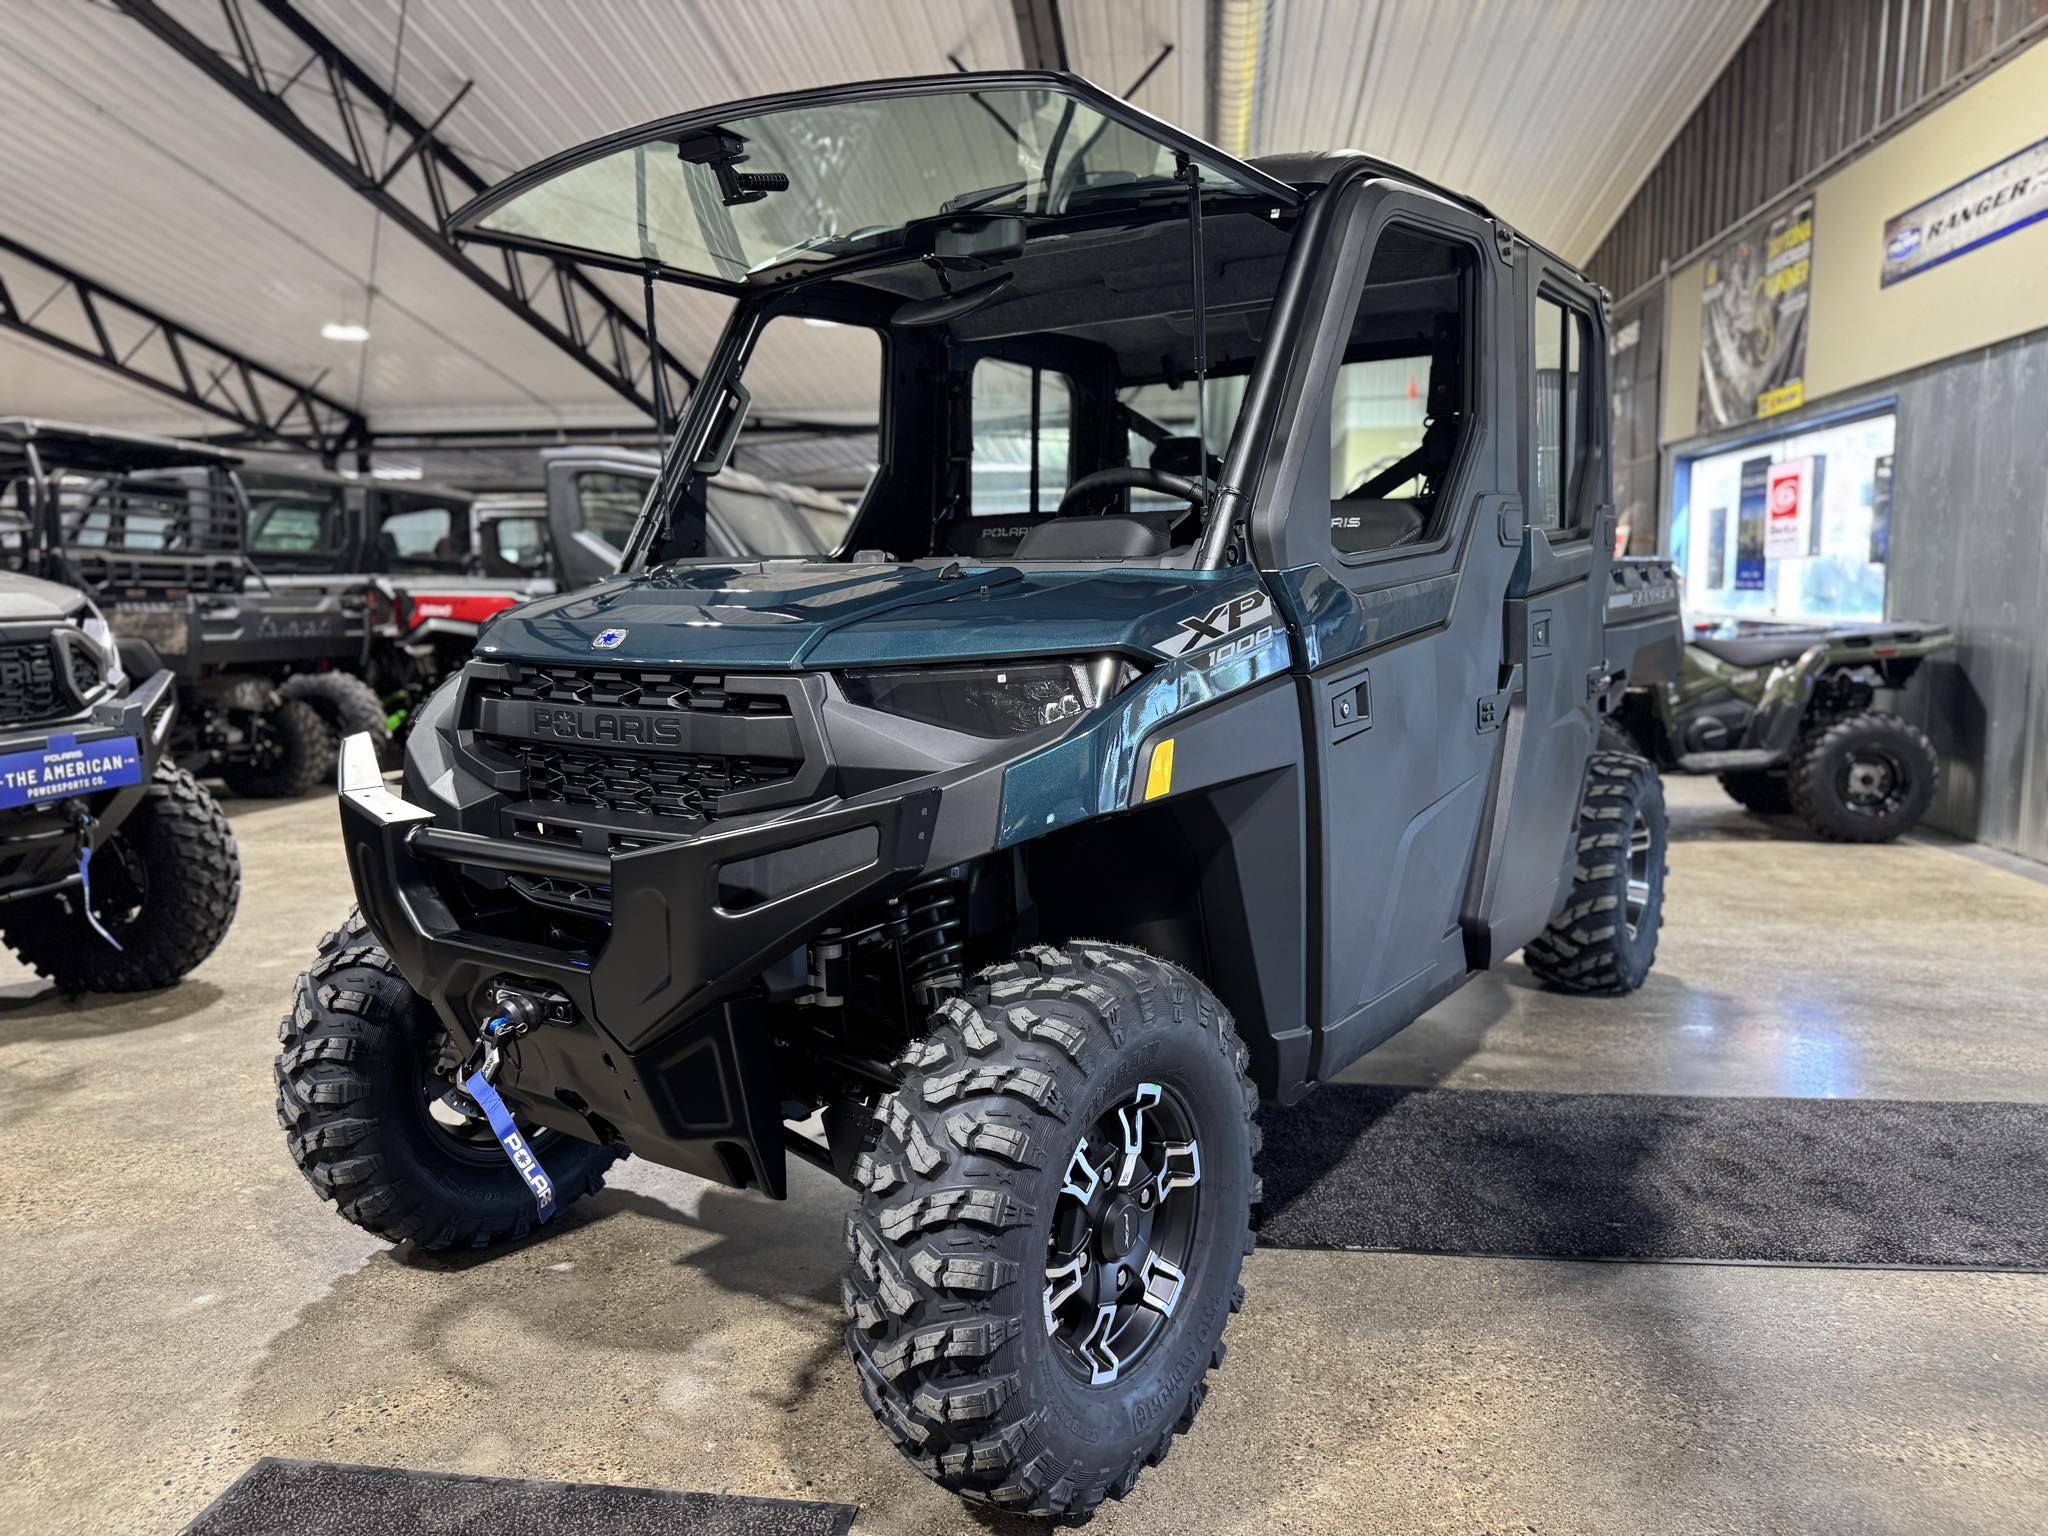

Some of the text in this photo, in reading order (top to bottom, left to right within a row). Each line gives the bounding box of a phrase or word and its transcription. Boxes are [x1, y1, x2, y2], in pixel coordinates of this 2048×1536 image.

[1927, 176, 2031, 241] RANGER
[982, 527, 1032, 539] POLAR
[1179, 591, 1266, 654] XP
[1208, 625, 1273, 667] 1000
[533, 708, 682, 746] POLARIS
[5, 755, 123, 788] THE AMERICAN
[43, 750, 84, 763] POLARIS
[27, 776, 107, 798] POWERSPORTS CO.
